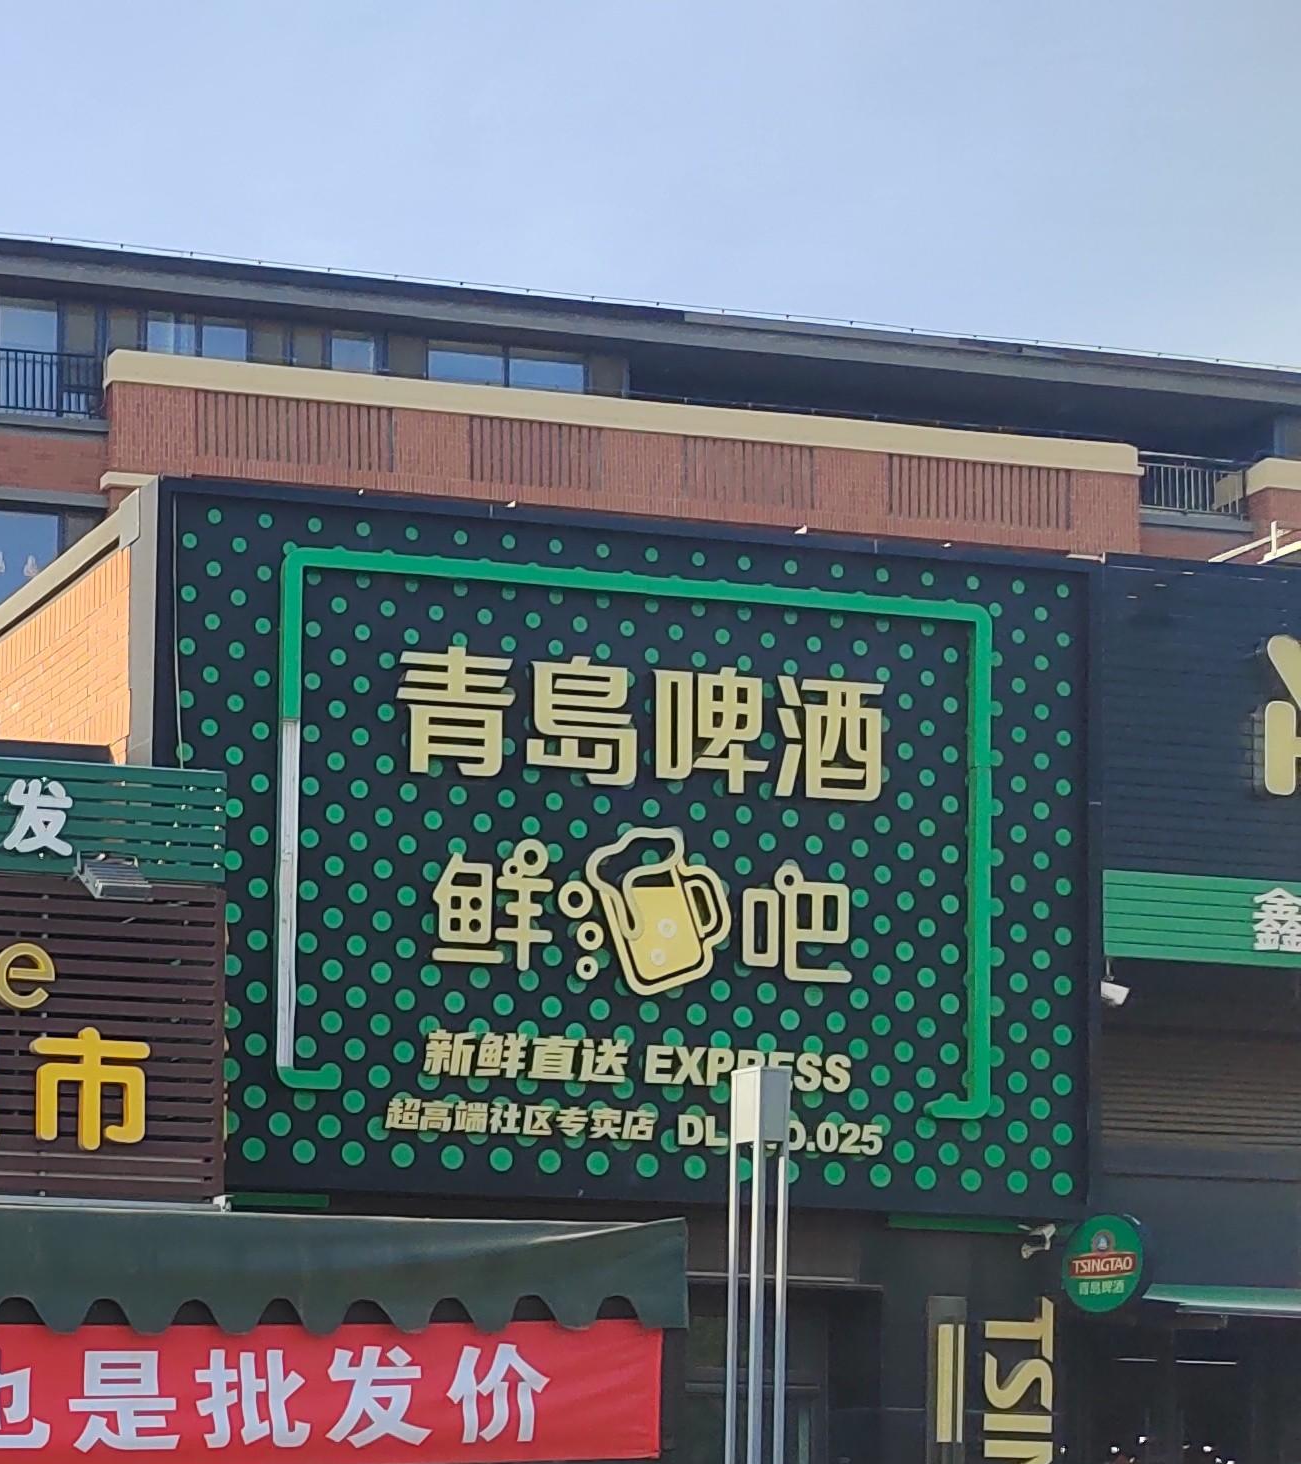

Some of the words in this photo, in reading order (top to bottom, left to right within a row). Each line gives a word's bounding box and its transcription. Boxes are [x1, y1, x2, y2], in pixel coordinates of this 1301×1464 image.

[396, 647, 885, 802] 青岛啤酒
[423, 1029, 628, 1083] 新鲜直送
[385, 1097, 657, 1141] 超高端社区专卖店
[677, 1114, 729, 1147] DL
[749, 1119, 884, 1156] O.025
[1072, 1256, 1133, 1274] TSINGTAO
